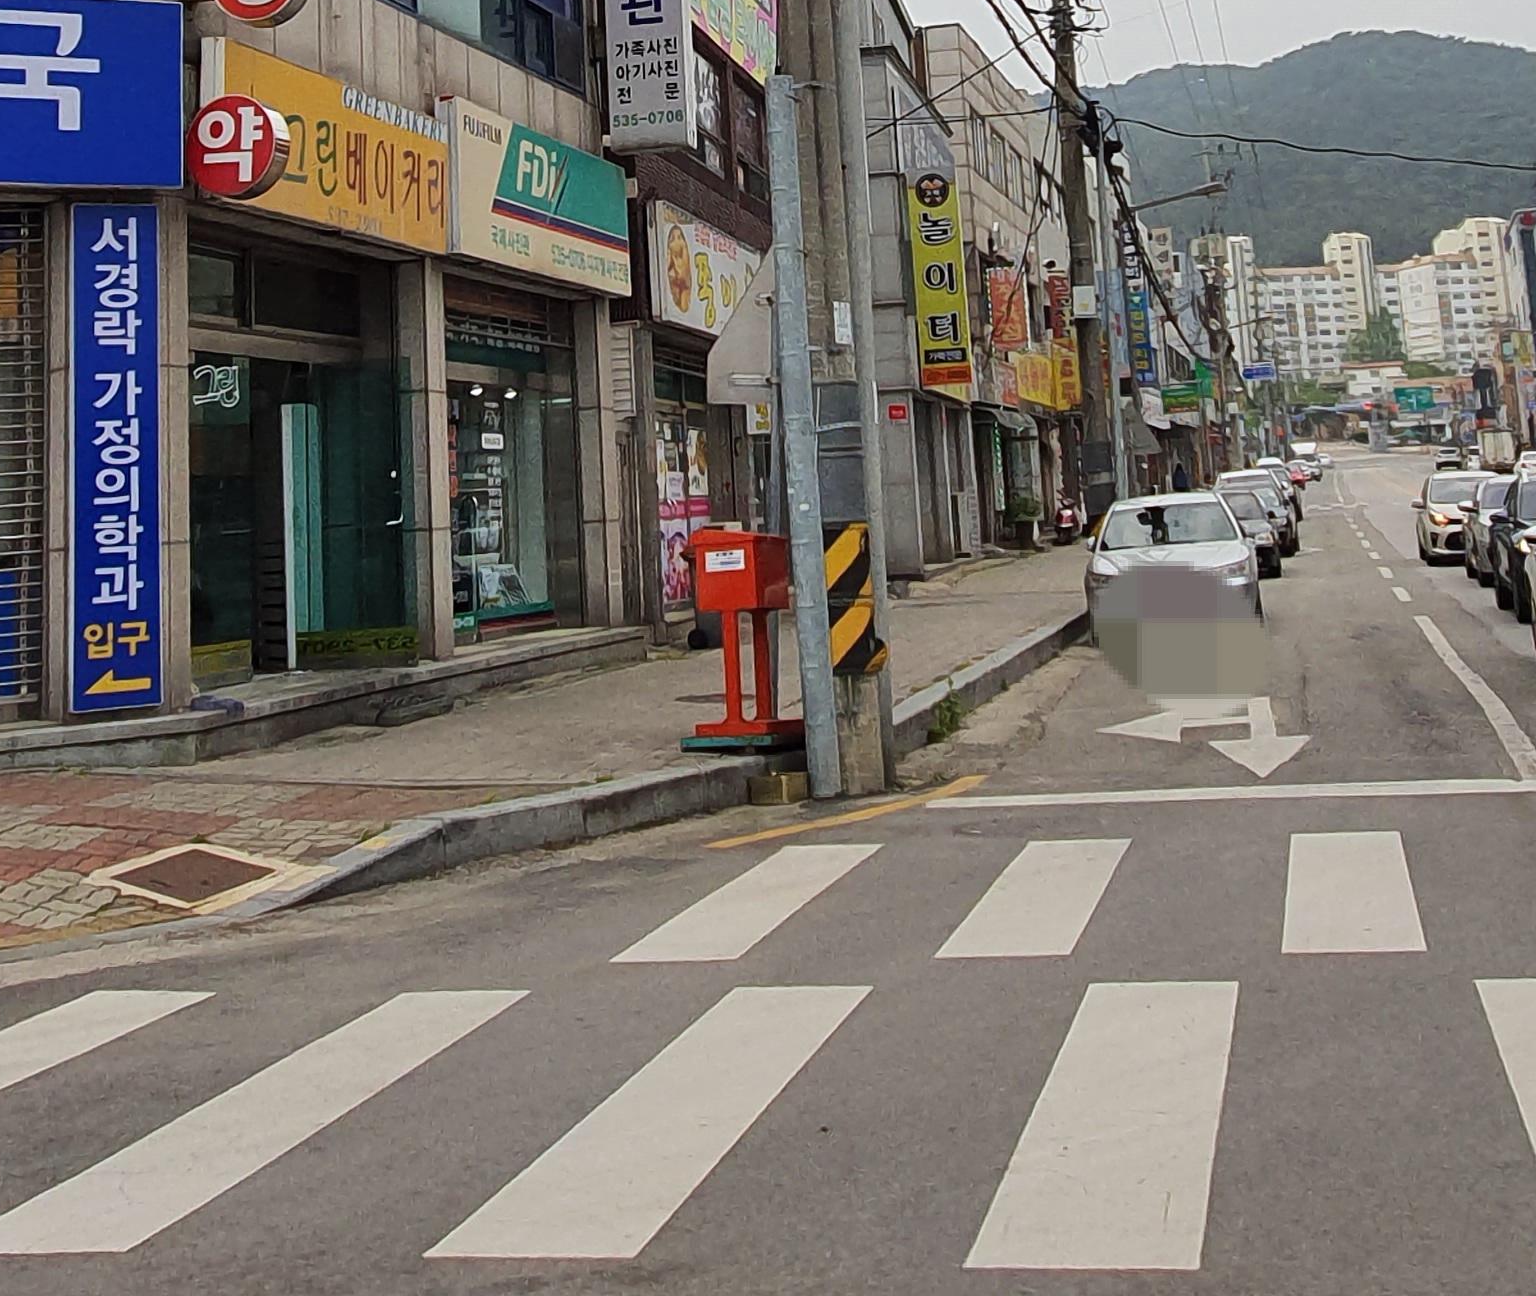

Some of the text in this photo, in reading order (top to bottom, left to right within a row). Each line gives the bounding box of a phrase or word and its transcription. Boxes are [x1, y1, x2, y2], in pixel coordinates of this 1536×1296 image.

[614, 36, 679, 59] 가족사진
[615, 59, 680, 82] 아기사진
[196, 111, 264, 183] 약
[463, 114, 503, 146] FUJIFILM
[917, 210, 963, 346] 놀이터
[193, 363, 240, 409] 그린
[90, 216, 145, 613] 서경락 가정의학과
[82, 620, 151, 660] 입구
